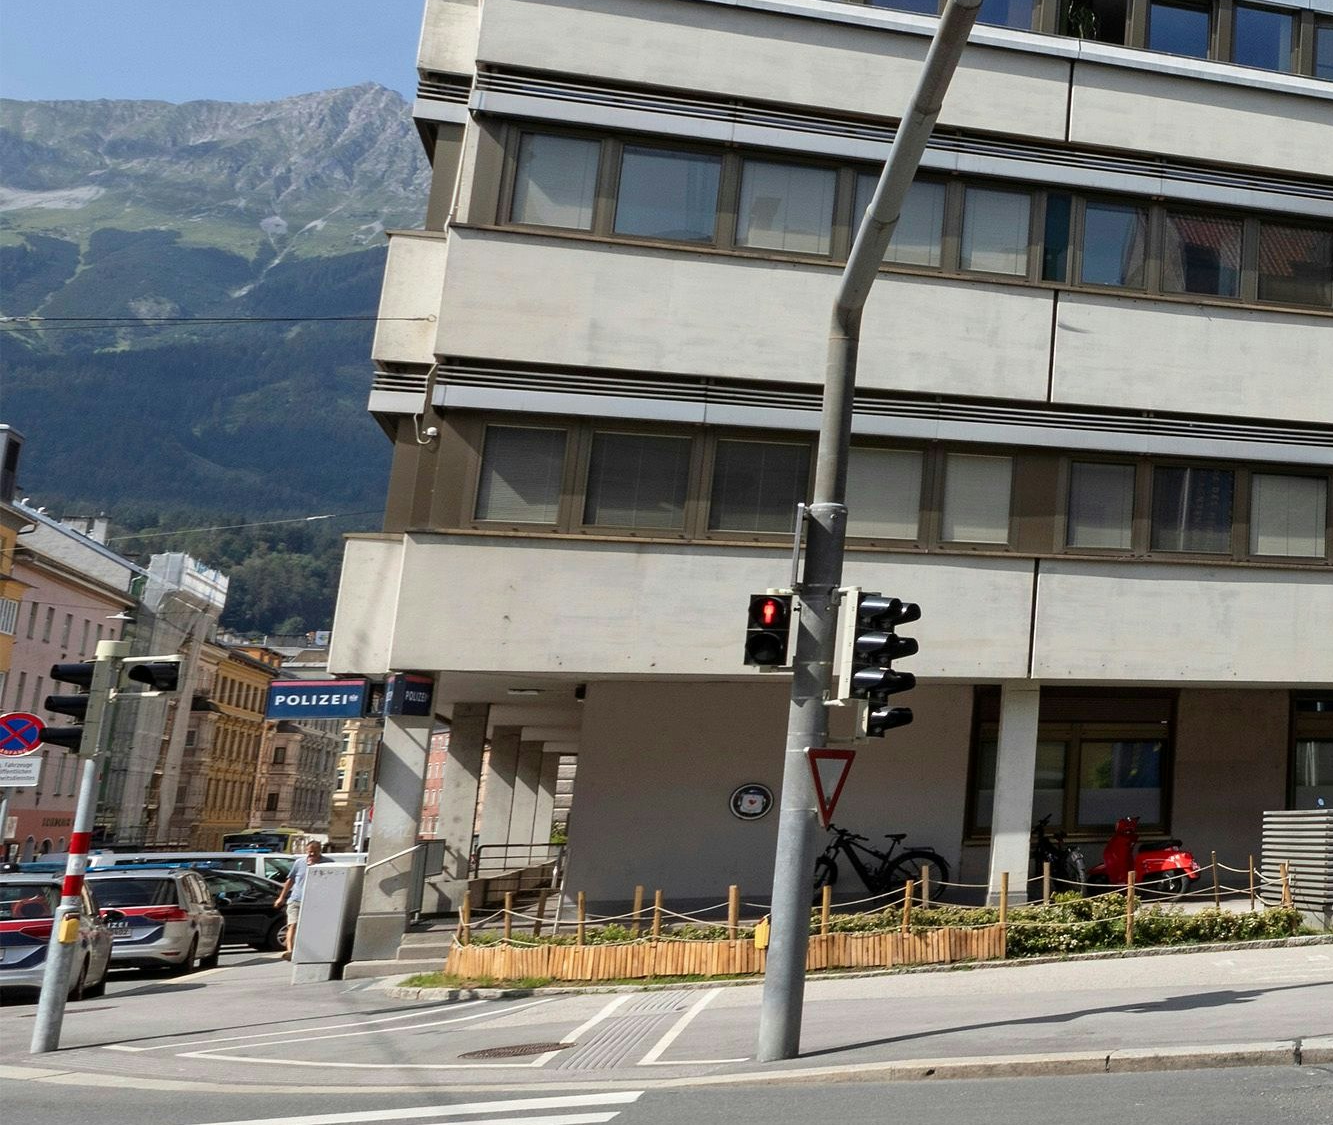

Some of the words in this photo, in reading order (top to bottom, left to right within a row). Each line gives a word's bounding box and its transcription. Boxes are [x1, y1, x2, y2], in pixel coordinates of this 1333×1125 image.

[274, 694, 347, 706] POLIZEI
[405, 691, 426, 702] POLIZEI
[107, 921, 128, 929] IZEI
